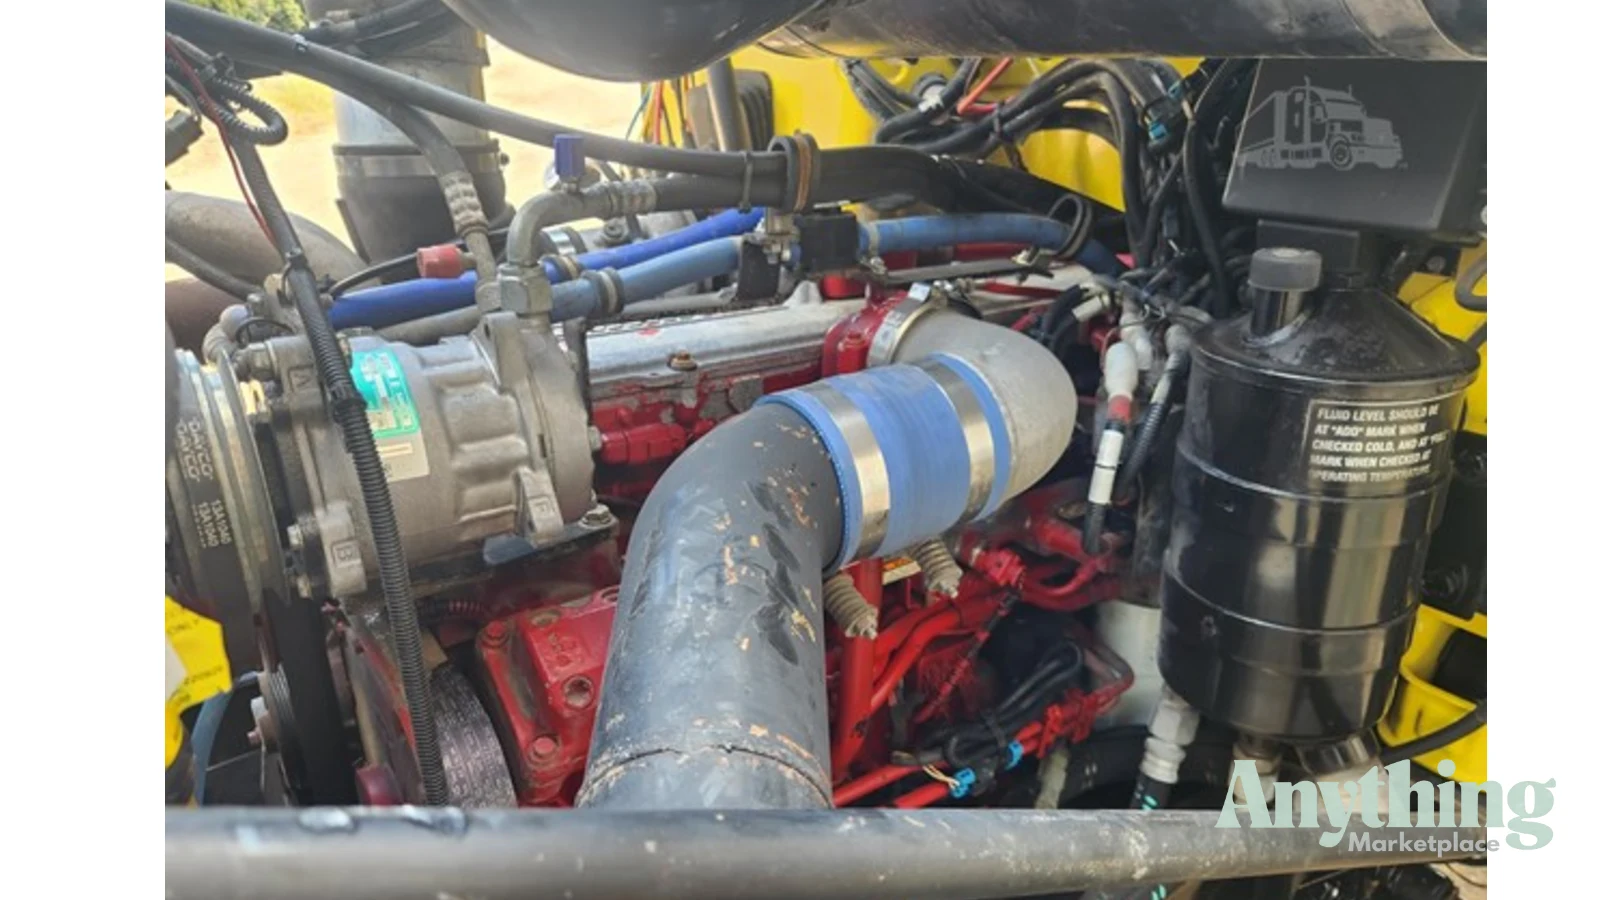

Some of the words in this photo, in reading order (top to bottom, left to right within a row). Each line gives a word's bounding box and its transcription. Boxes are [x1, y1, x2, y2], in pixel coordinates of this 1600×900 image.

[1317, 408, 1350, 420] FLUID
[1353, 409, 1385, 422] LEVEL
[1388, 406, 1427, 421] SHOULD
[1314, 424, 1328, 435] AT
[1365, 425, 1397, 437] MARK
[1399, 422, 1427, 436] WHEN
[1312, 439, 1363, 452] CHECKED
[1397, 438, 1418, 451] AND
[1309, 455, 1344, 467] MARK
[1344, 456, 1377, 468] WHEN
[1379, 452, 1421, 467] CHECKED
